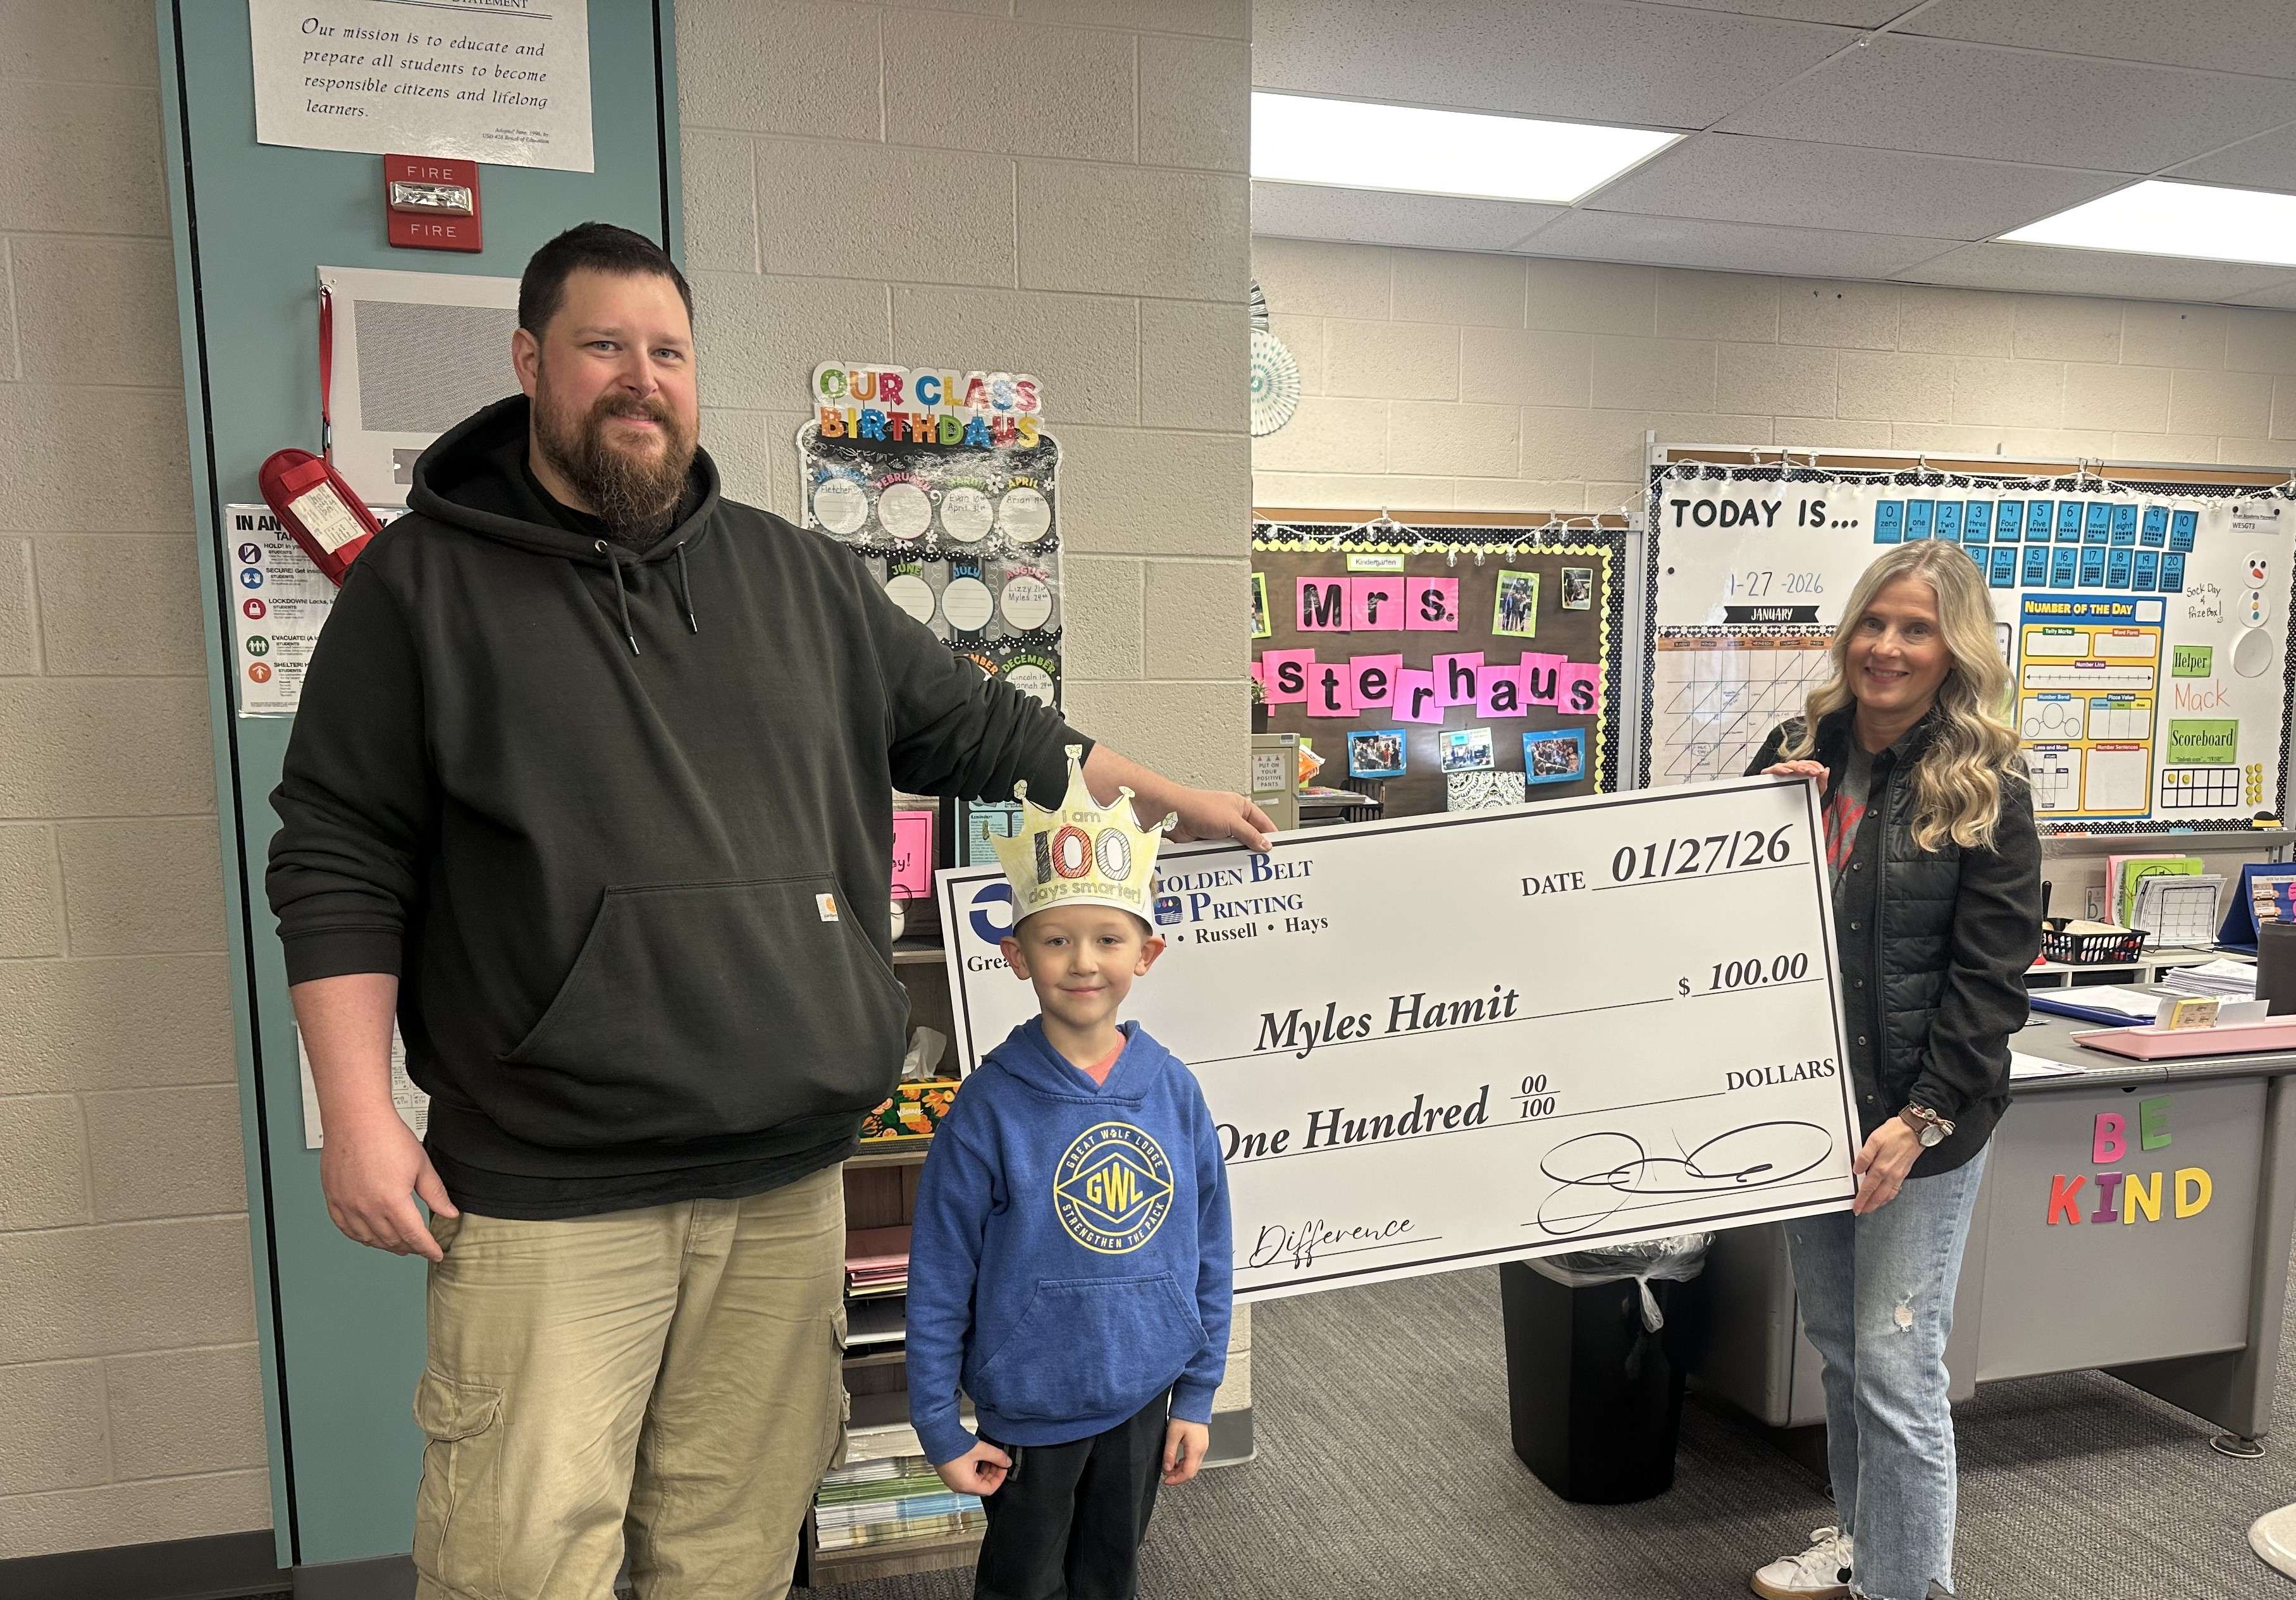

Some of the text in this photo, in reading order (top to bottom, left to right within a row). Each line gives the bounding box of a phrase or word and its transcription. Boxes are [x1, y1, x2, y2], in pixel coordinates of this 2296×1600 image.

[302, 18, 545, 56] Our mission is to educate and
[303, 49, 546, 82] prepare all students to become
[304, 75, 548, 110] responsible citizens and lifelong
[306, 99, 369, 118] learners.
[407, 165, 454, 181] FIRE
[410, 223, 457, 238] FIRE
[820, 369, 1037, 412] OUR CLASS
[820, 406, 1039, 448] BIRTHDAYS
[821, 484, 851, 494] Fletcher
[1008, 476, 1039, 490] APRIL
[949, 493, 969, 503] Evan
[1670, 498, 1858, 529] TODAY IS...
[1886, 505, 1893, 517] 0
[1918, 504, 1922, 515] 1
[1945, 507, 1952, 518] 2
[1975, 506, 1982, 517] 3
[2007, 505, 2013, 516] 4
[2037, 505, 2044, 516] 5
[2067, 505, 2073, 517] 6
[2097, 507, 2103, 519] 7
[2121, 508, 2128, 520] 8
[2153, 510, 2159, 522] 9
[236, 515, 254, 531] IN
[1940, 520, 1956, 528] two
[2032, 519, 2047, 527] five
[2116, 522, 2133, 531] eight
[2180, 515, 2188, 527] 10
[2000, 551, 2008, 561] 14
[2032, 550, 2040, 560] 15
[2060, 551, 2069, 562] 16
[2089, 550, 2097, 561] 17
[2116, 552, 2124, 562] 18
[2142, 555, 2150, 565] 19
[2167, 556, 2179, 566] 20
[891, 563, 922, 576] JUNE
[954, 566, 980, 578] JULY
[1008, 592, 1030, 603] Myles
[1009, 584, 1032, 596] Lizzy
[2187, 582, 2221, 598] Sock Day
[1303, 582, 1455, 628] Mrs.
[1750, 607, 1794, 621] JANUARY
[1001, 655, 1056, 675] DECEMBER
[2175, 651, 2207, 670] Helper
[1011, 671, 1037, 680] Lincoln
[1278, 656, 1595, 719] sterhaus
[2175, 679, 2231, 711] Mack
[2171, 728, 2233, 746] Scoreboard
[1062, 810, 1101, 823] I am
[1034, 826, 1132, 885] 100
[1521, 823, 1794, 897] DATE 01/27/26
[1028, 883, 1141, 904] days smarter!
[2087, 890, 2099, 919] b
[967, 916, 1329, 972] Grea Russell Hays
[1678, 952, 1809, 999] $ 100.00
[1253, 984, 1519, 1059] Myles Hamit
[1726, 1057, 1835, 1092] DOLLARS
[1521, 1074, 1547, 1095] 00
[1520, 1095, 1556, 1119] 100
[1215, 1084, 1490, 1162] One Hundred
[2092, 1095, 2173, 1164] BE
[1066, 1135, 1096, 1169] GREAT
[1135, 1136, 1164, 1169] LODGE
[1086, 1161, 1144, 1213] GWL
[2047, 1167, 2213, 1225] KIND
[1061, 1202, 1165, 1248] STRENGTHEN THE PACK
[1249, 1219, 1416, 1270] Difference
